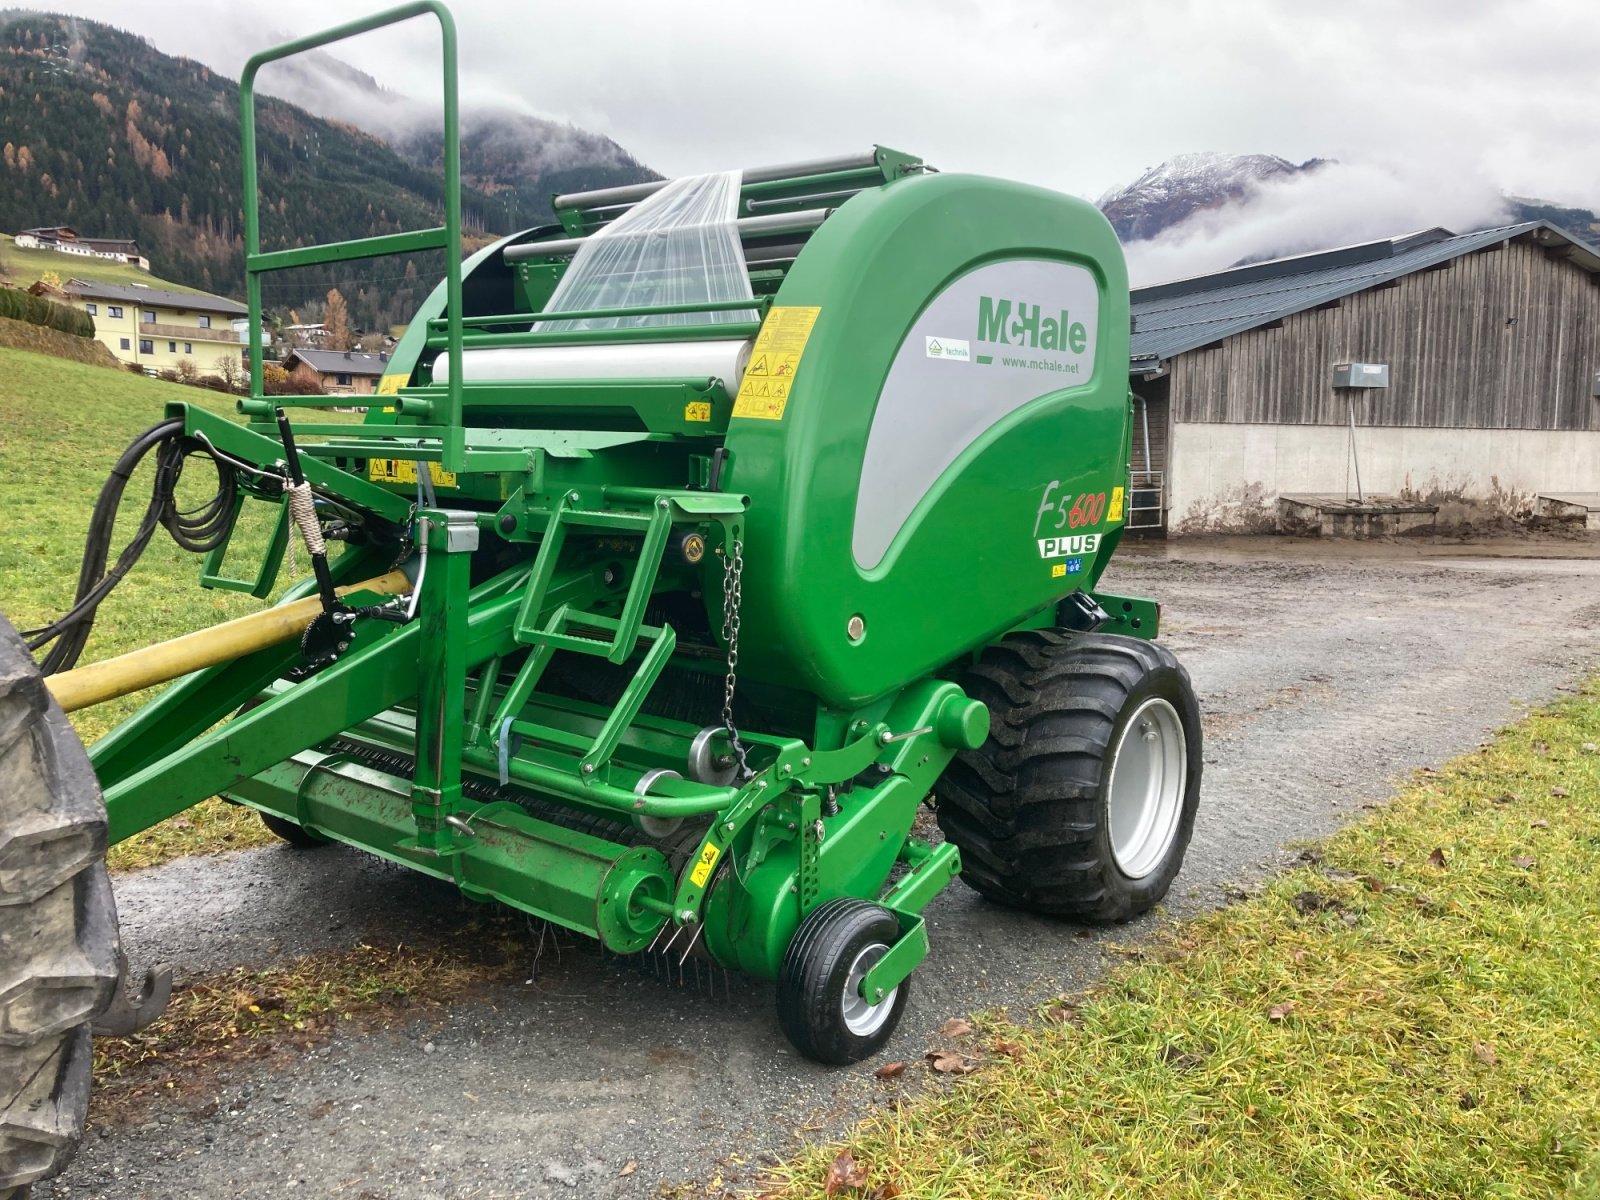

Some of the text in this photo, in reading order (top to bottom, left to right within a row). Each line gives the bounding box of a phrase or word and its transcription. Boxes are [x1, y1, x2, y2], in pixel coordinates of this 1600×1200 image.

[977, 295, 1087, 354] McHale
[1002, 357, 1079, 374] www.mchale.net
[1044, 535, 1096, 557] PLUS
